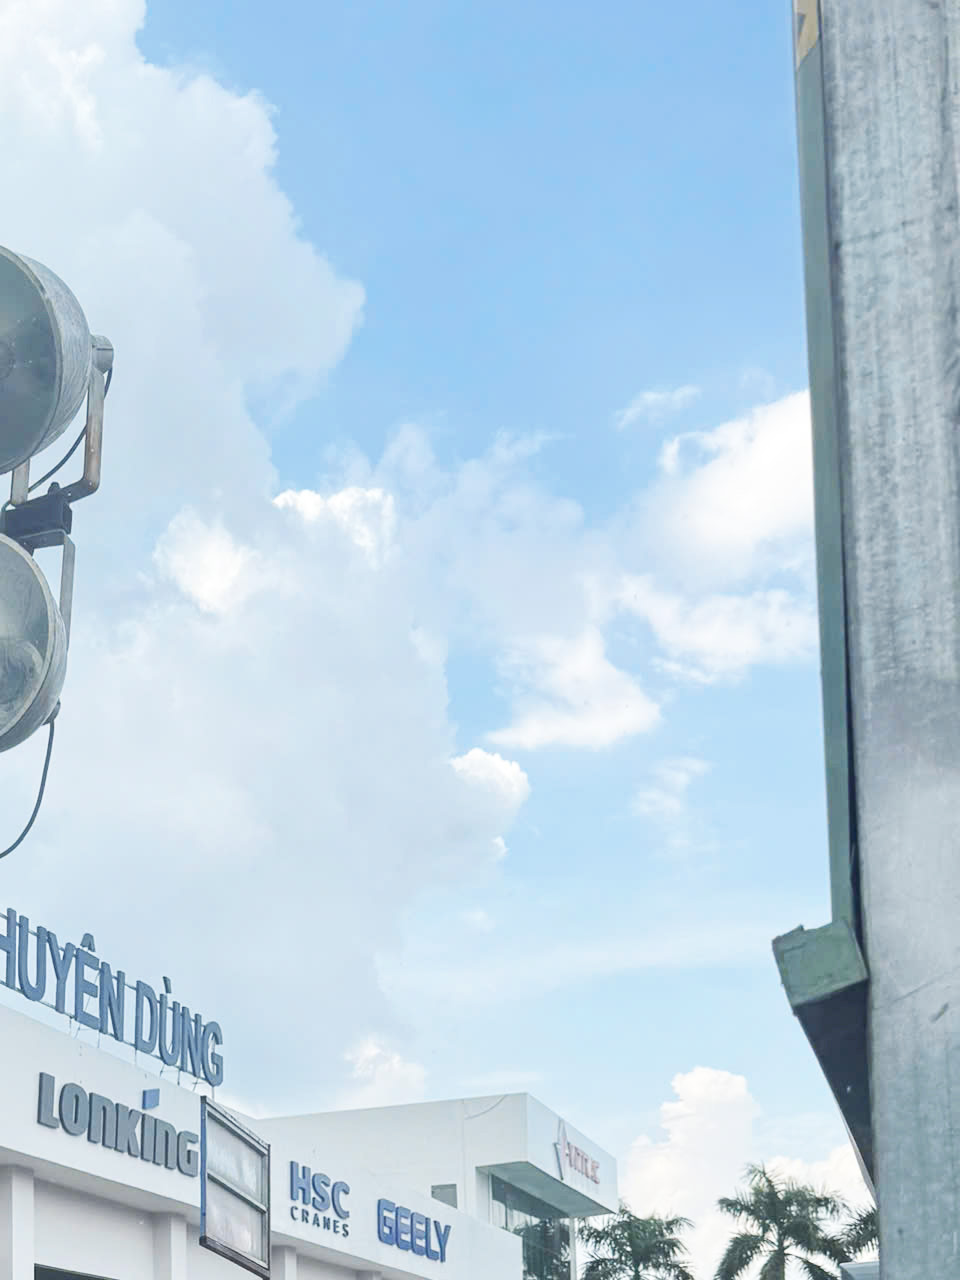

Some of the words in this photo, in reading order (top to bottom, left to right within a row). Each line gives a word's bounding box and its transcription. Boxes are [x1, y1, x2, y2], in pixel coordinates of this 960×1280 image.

[135, 976, 224, 1087] DÙNG
[289, 1160, 351, 1220] HSC
[290, 1205, 350, 1238] CRANES
[377, 1198, 452, 1263] GEELY
